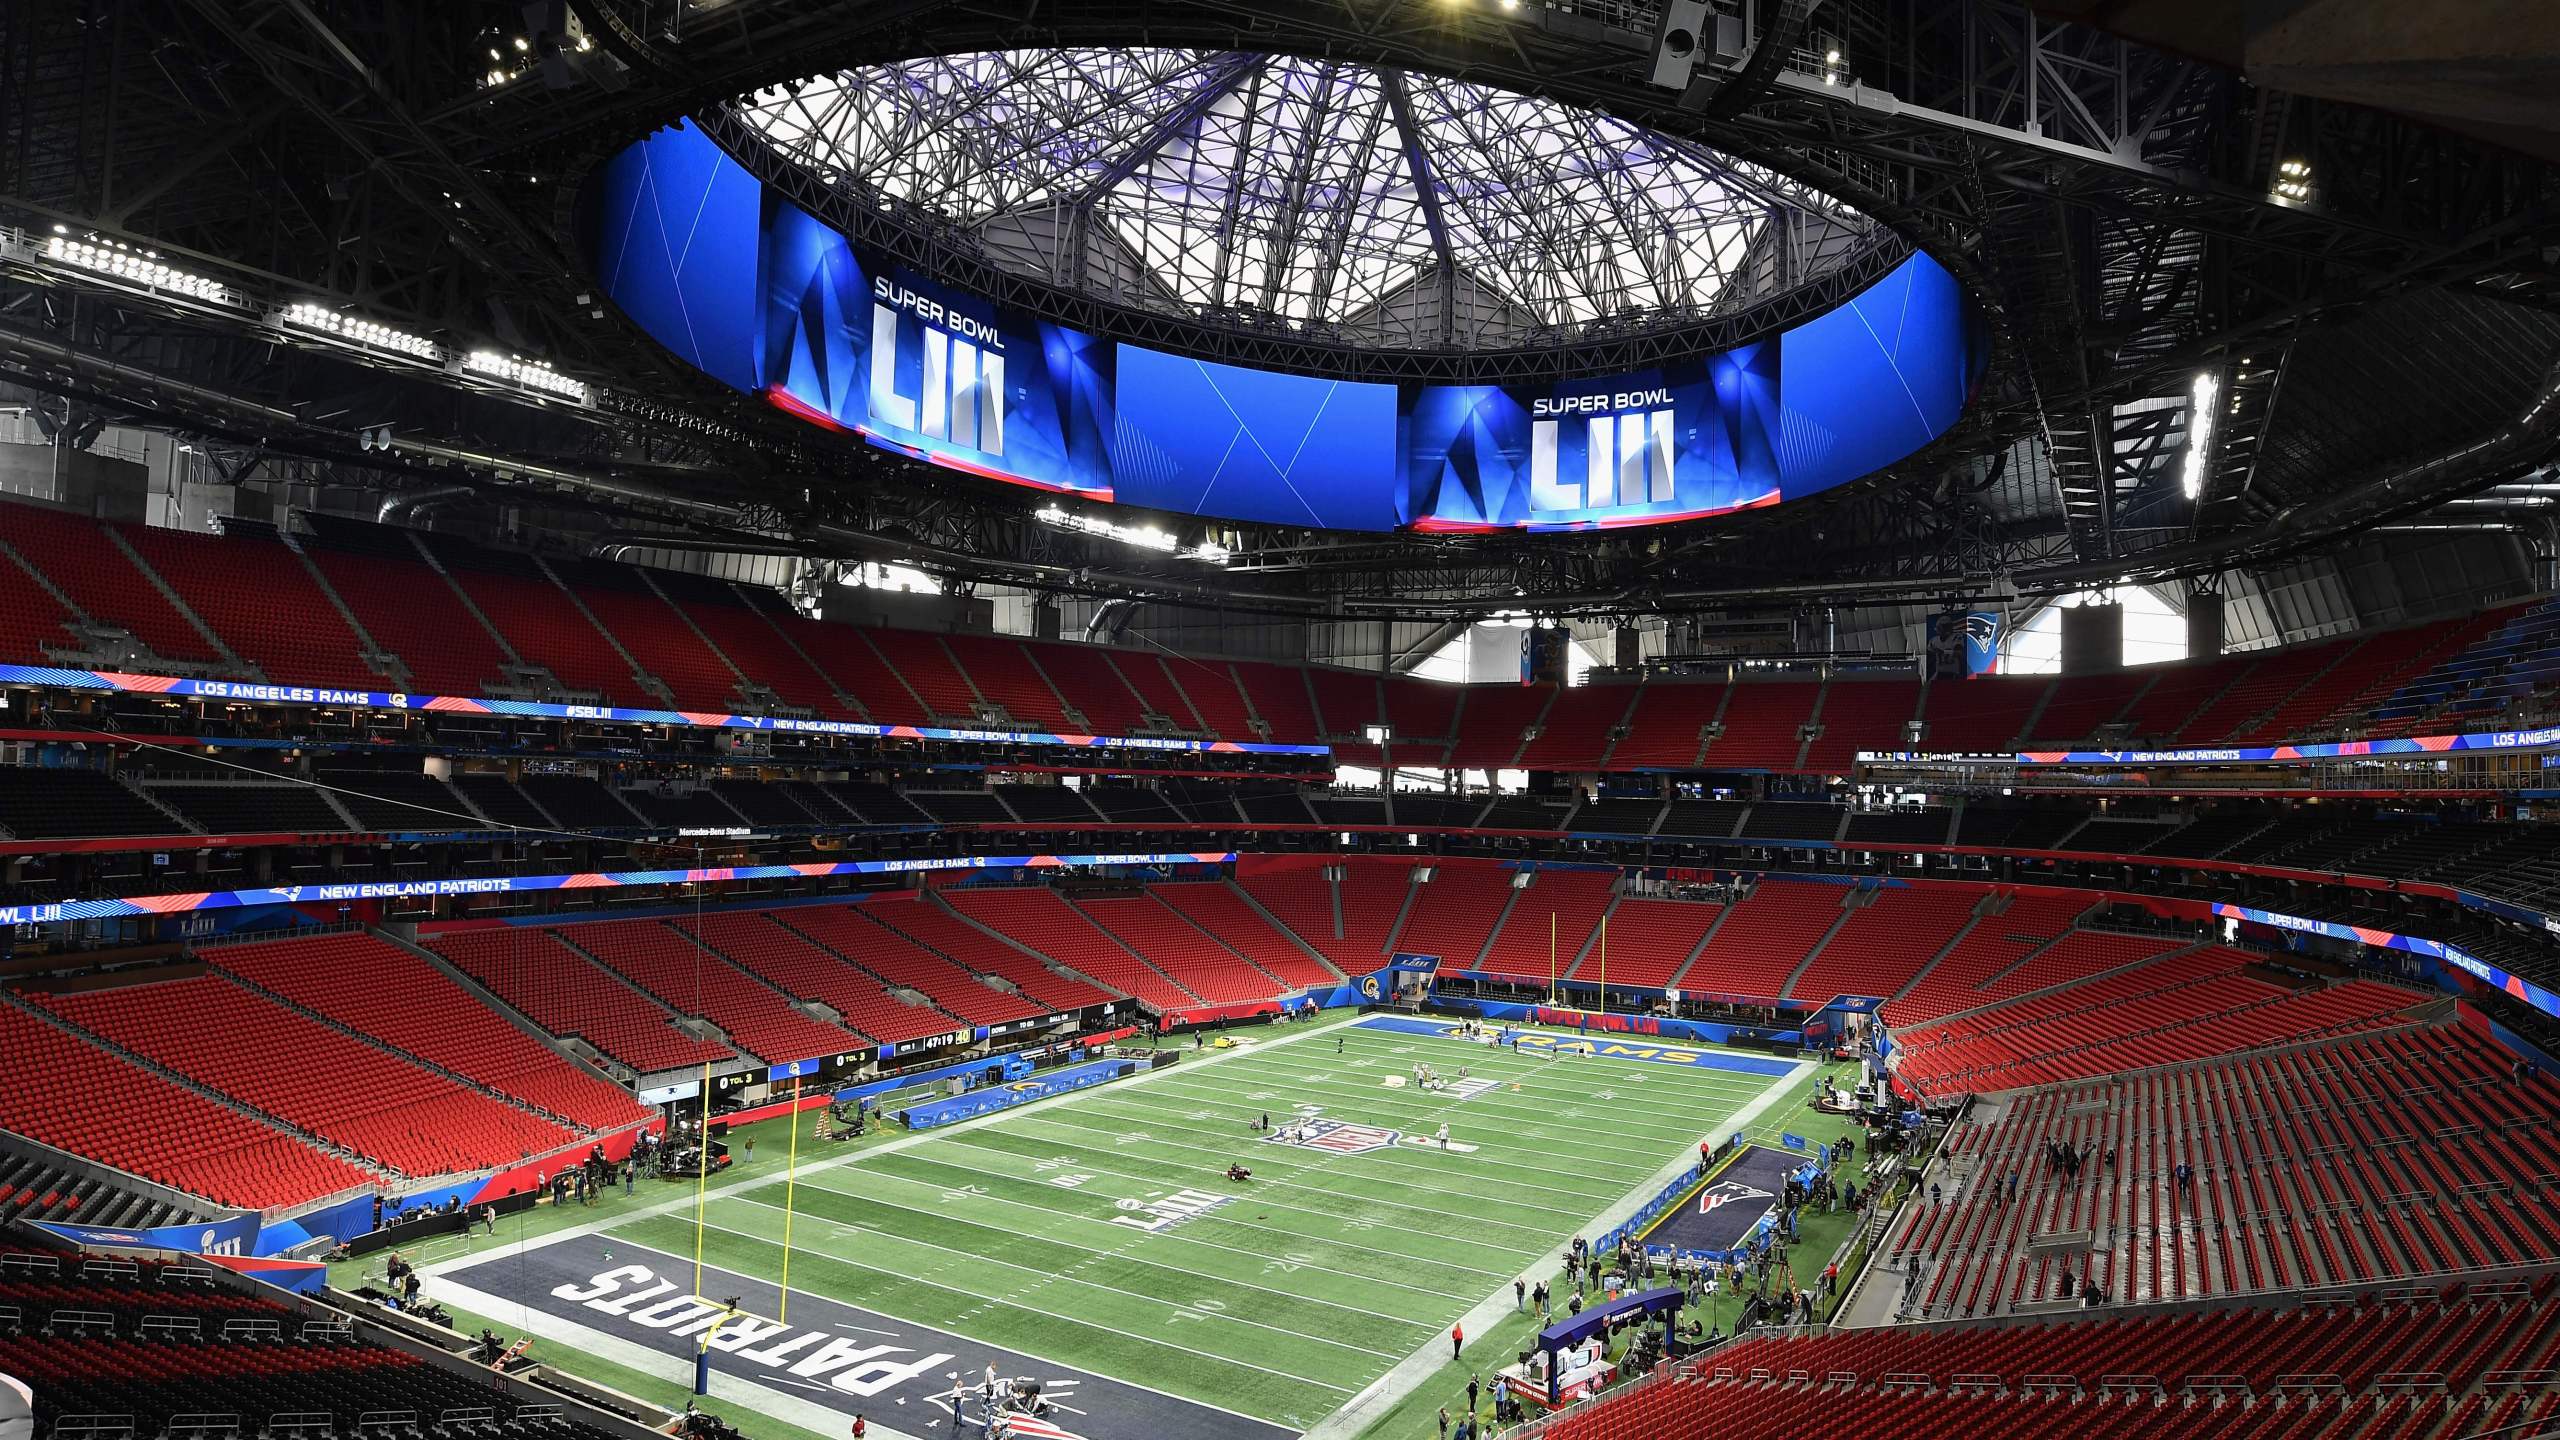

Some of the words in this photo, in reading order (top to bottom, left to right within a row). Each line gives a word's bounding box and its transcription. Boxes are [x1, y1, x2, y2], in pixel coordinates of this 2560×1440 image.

[874, 274, 944, 325] SUPER
[948, 309, 1005, 349] BOWL
[869, 302, 1005, 457] LIII
[1532, 394, 1609, 415] SUPER
[1614, 387, 1674, 409] BOWL
[1529, 408, 1675, 513] LIII
[194, 682, 227, 696] LOS
[231, 684, 314, 702] ANGELES
[318, 690, 369, 705] RAMS
[566, 704, 612, 719] #SBLIII
[773, 719, 795, 730] NEW
[796, 721, 839, 733] ENGLAND
[839, 723, 881, 735] PATRIOTS
[949, 729, 984, 740] SUPER
[986, 731, 1013, 741] BOWL
[1105, 737, 1122, 746] LOS
[1123, 738, 1162, 748] ANGELES
[1163, 740, 1187, 749] RAMS
[2493, 734, 2515, 746] LOS
[2517, 730, 2550, 745] ANGELES
[2132, 752, 2155, 761] NEW
[2155, 751, 2195, 761] ENGLAND
[2195, 750, 2241, 760] PATRIOTS
[679, 827, 725, 836] Mercedes-Benz
[725, 827, 751, 836] Stadium
[884, 861, 903, 872] LOS
[904, 859, 945, 870] ANGELES
[945, 857, 970, 868] RAMS
[1095, 855, 1127, 864] SUPER
[1128, 853, 1153, 863] BOWL
[319, 886, 358, 899] NEW
[360, 883, 437, 898] ENGLAND
[439, 879, 511, 893] PATRIOTS
[2267, 912, 2293, 929] SUPER
[2293, 918, 2315, 933] BOWL
[991, 1025, 1007, 1035] DOWN
[1027, 1020, 1034, 1028] GO
[926, 1033, 954, 1049] 47:19
[957, 1030, 969, 1042] 40
[1515, 1035, 1701, 1063] RAMS
[836, 1055, 844, 1066] 0
[845, 1054, 858, 1063] TOL
[859, 1052, 866, 1062] 3
[719, 1075, 729, 1089] 0
[729, 1076, 744, 1086] TOL
[745, 1073, 753, 1084] 3
[551, 1264, 957, 1398] PATRIOTS
[1514, 1382, 1548, 1403] NETWORK
